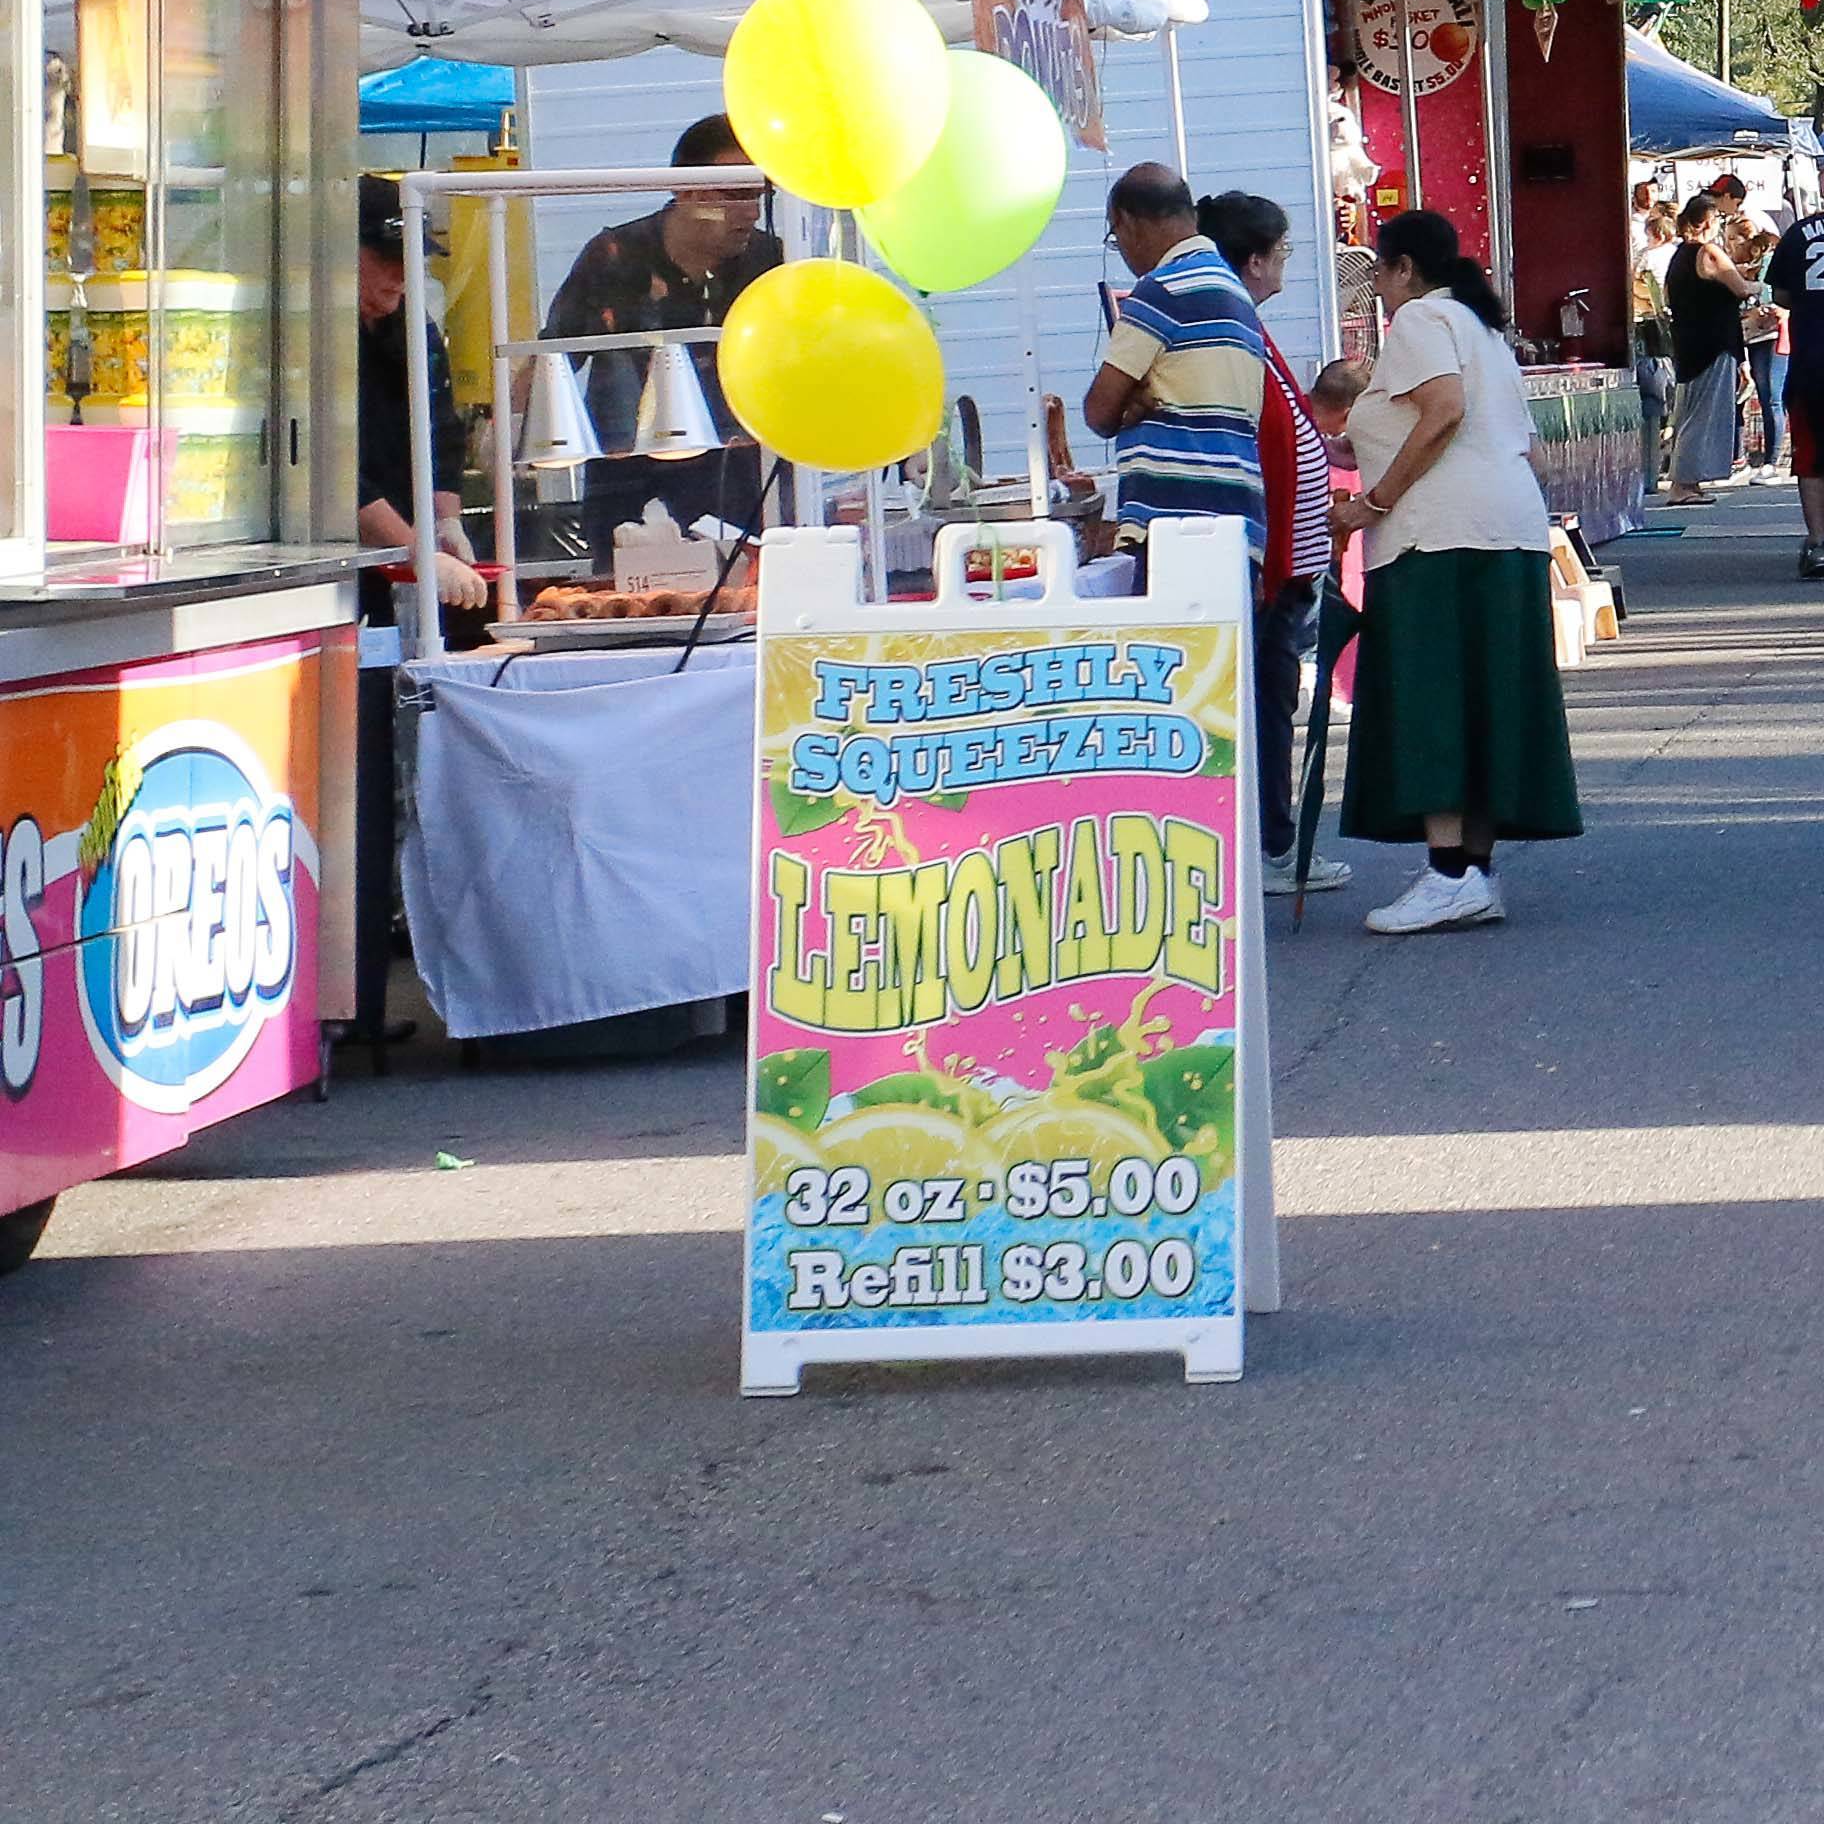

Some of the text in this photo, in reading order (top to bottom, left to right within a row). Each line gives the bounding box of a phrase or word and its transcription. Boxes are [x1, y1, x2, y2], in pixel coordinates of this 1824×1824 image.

[812, 643, 1184, 725] FRESHLY
[791, 713, 1208, 806] SQUEEZED
[112, 806, 297, 1042] OREOS
[766, 813, 1225, 1036] LEMONADE
[785, 1154, 1200, 1227] 32 oz $5.00
[788, 1238, 1196, 1311] Refill $3.00
